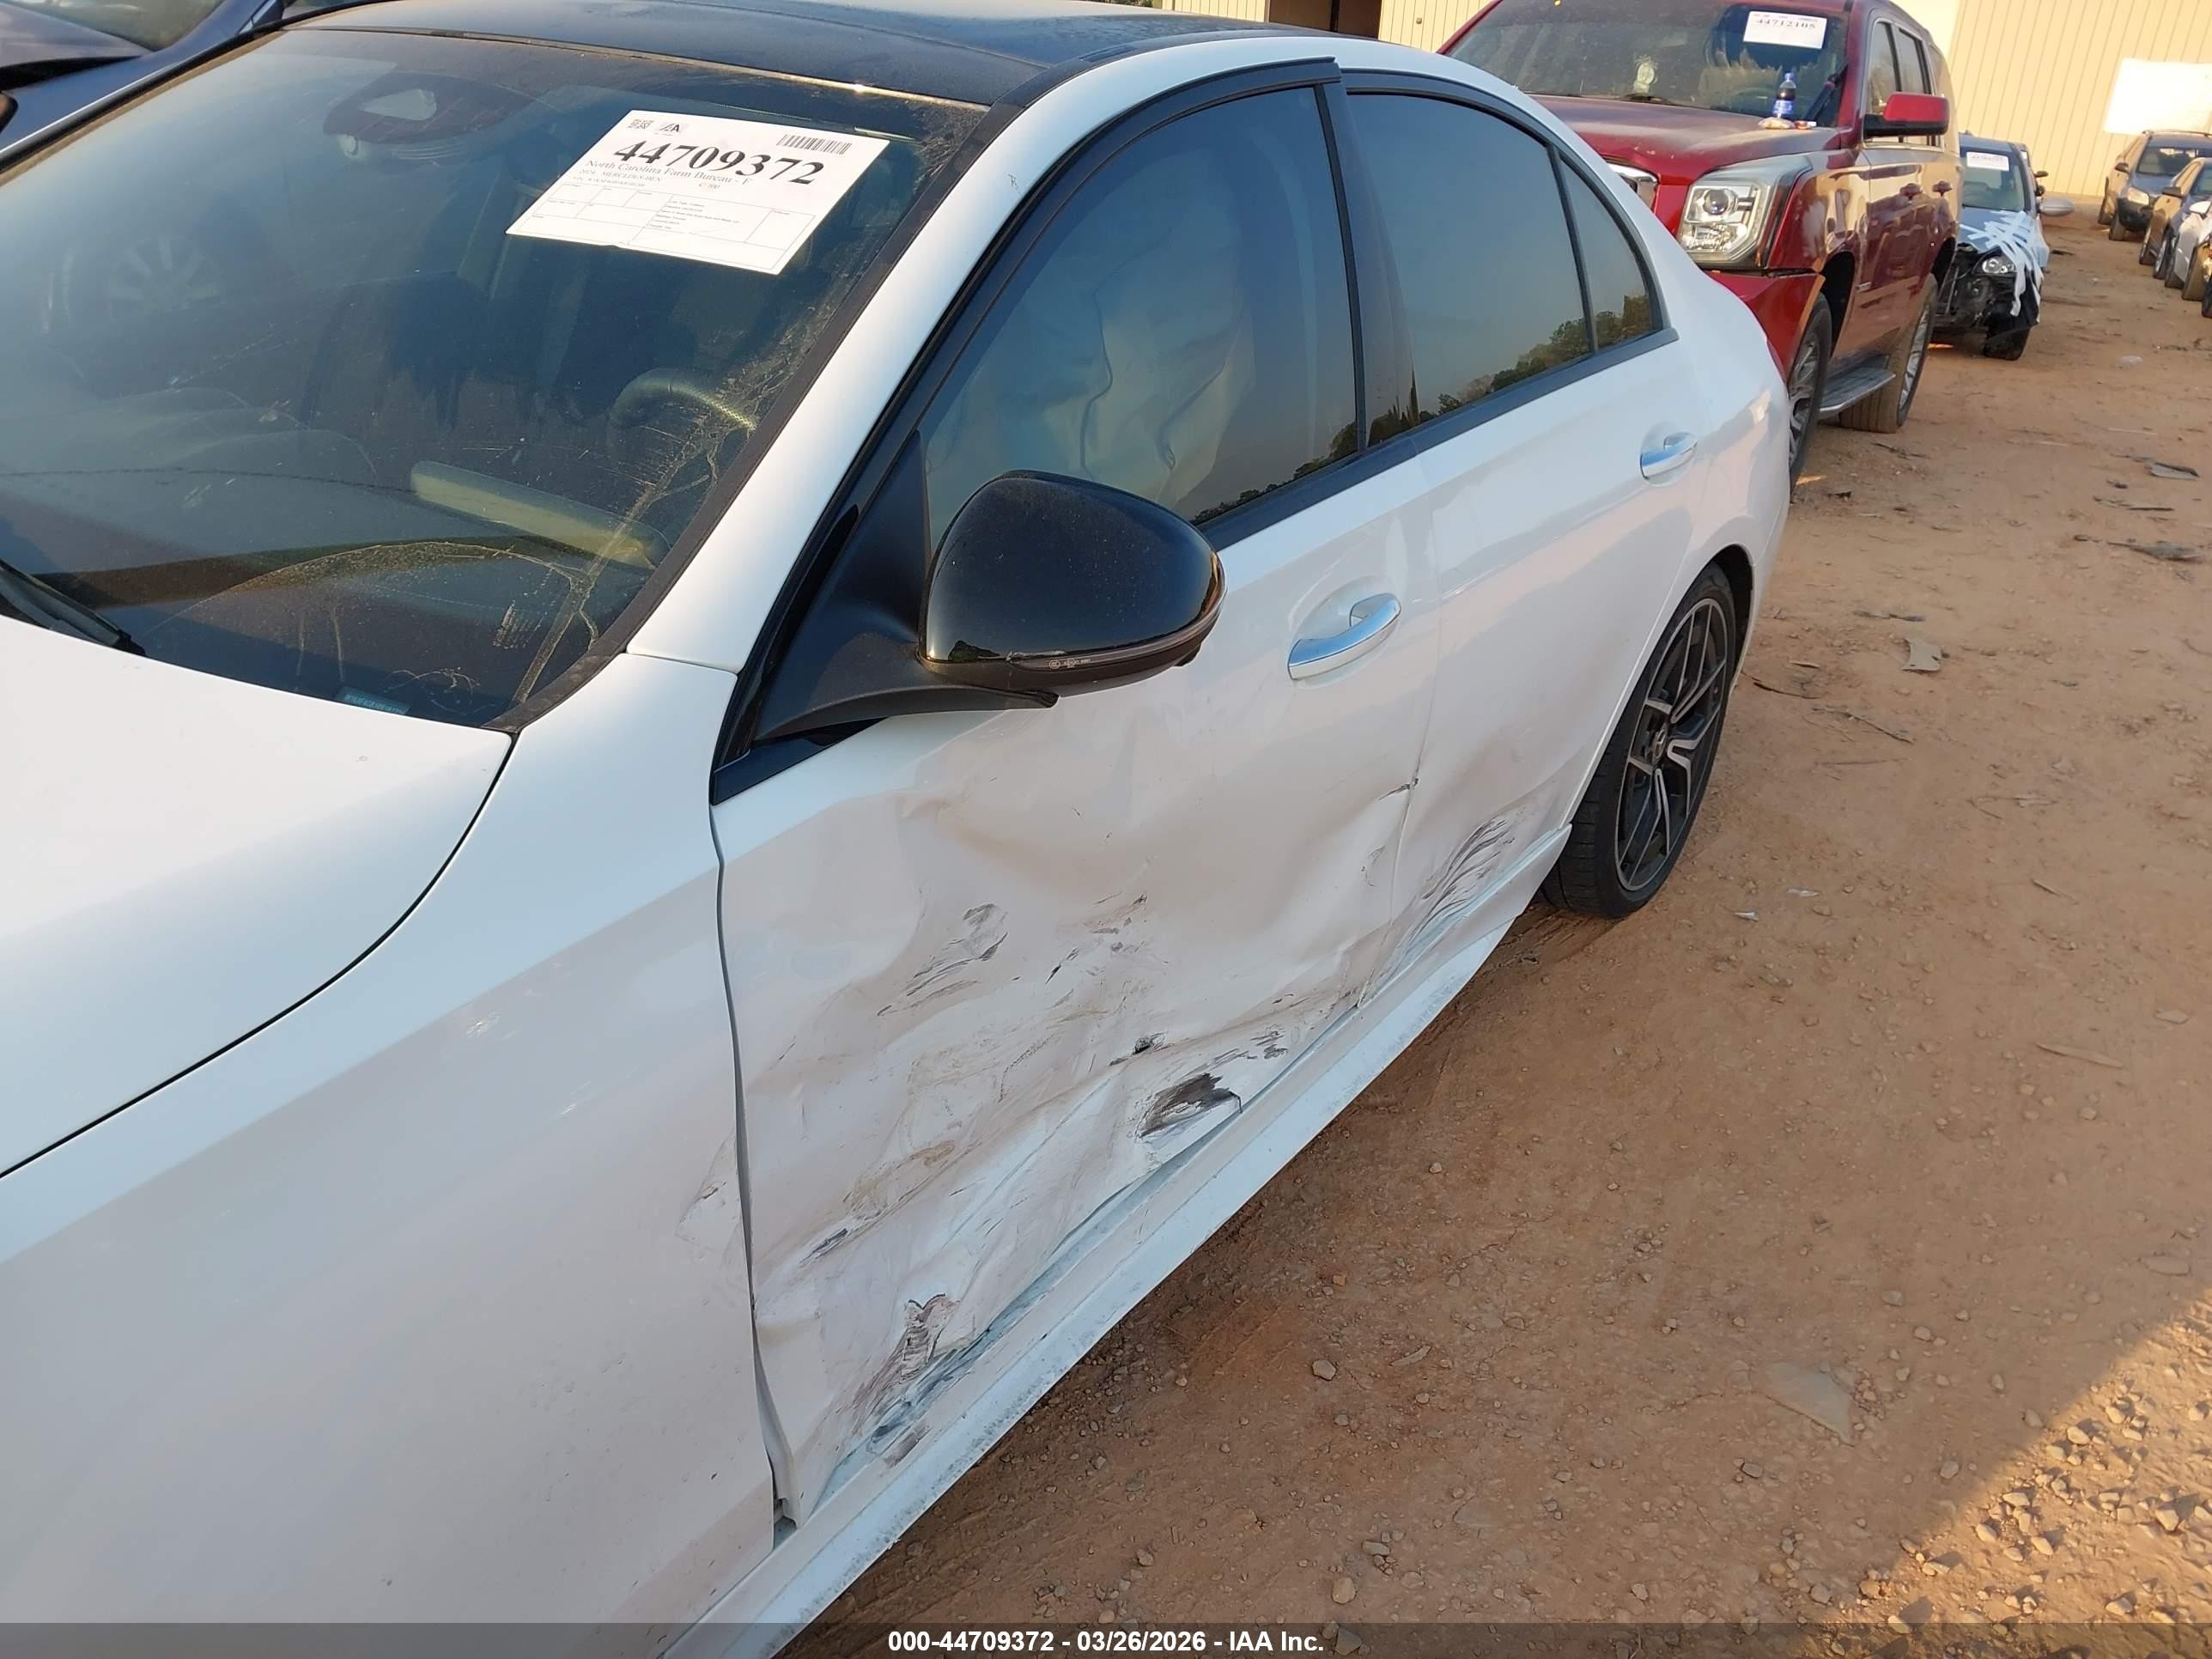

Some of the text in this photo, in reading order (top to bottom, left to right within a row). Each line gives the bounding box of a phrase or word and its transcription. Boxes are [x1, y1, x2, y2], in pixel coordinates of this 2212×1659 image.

[586, 161, 616, 170] North
[617, 163, 662, 175] Carolina
[664, 168, 690, 179] Farm
[693, 171, 732, 183] Bureau
[613, 140, 824, 185] 44709372
